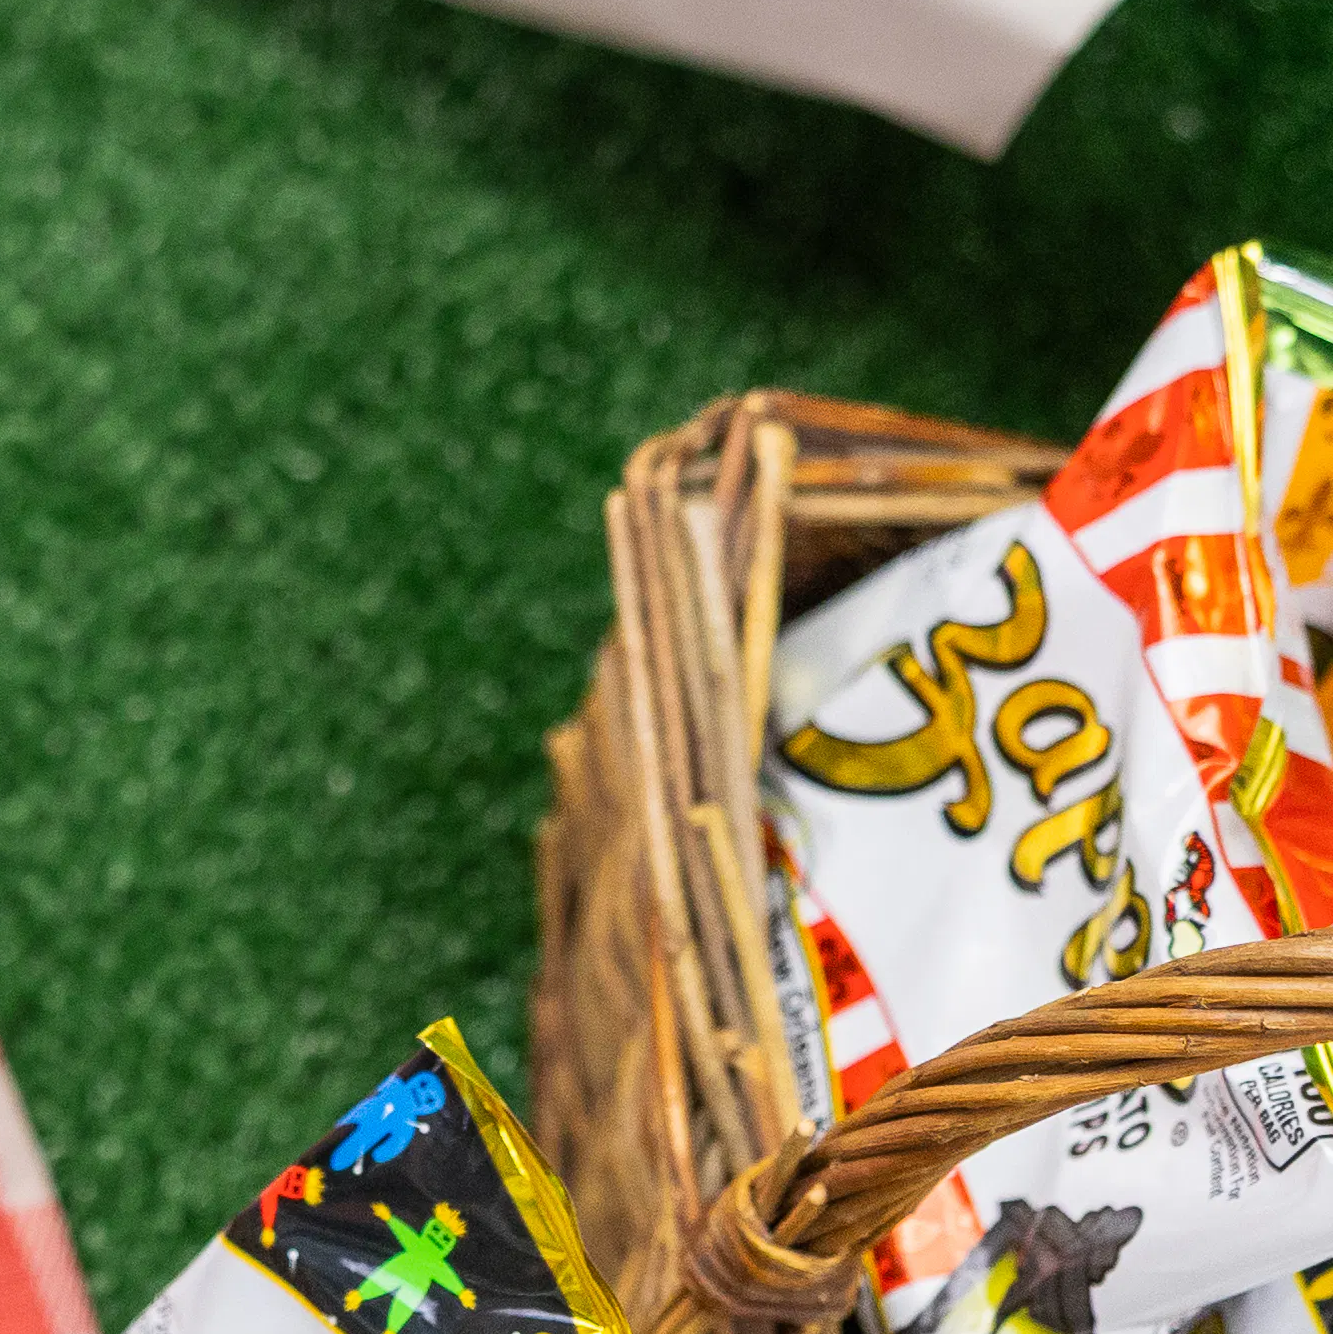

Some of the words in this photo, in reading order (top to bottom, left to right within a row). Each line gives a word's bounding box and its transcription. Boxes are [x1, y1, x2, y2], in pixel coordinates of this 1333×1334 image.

[1240, 1079, 1265, 1111] PER
[1257, 1109, 1282, 1146] BAG
[1258, 1063, 1306, 1147] CALORIES
